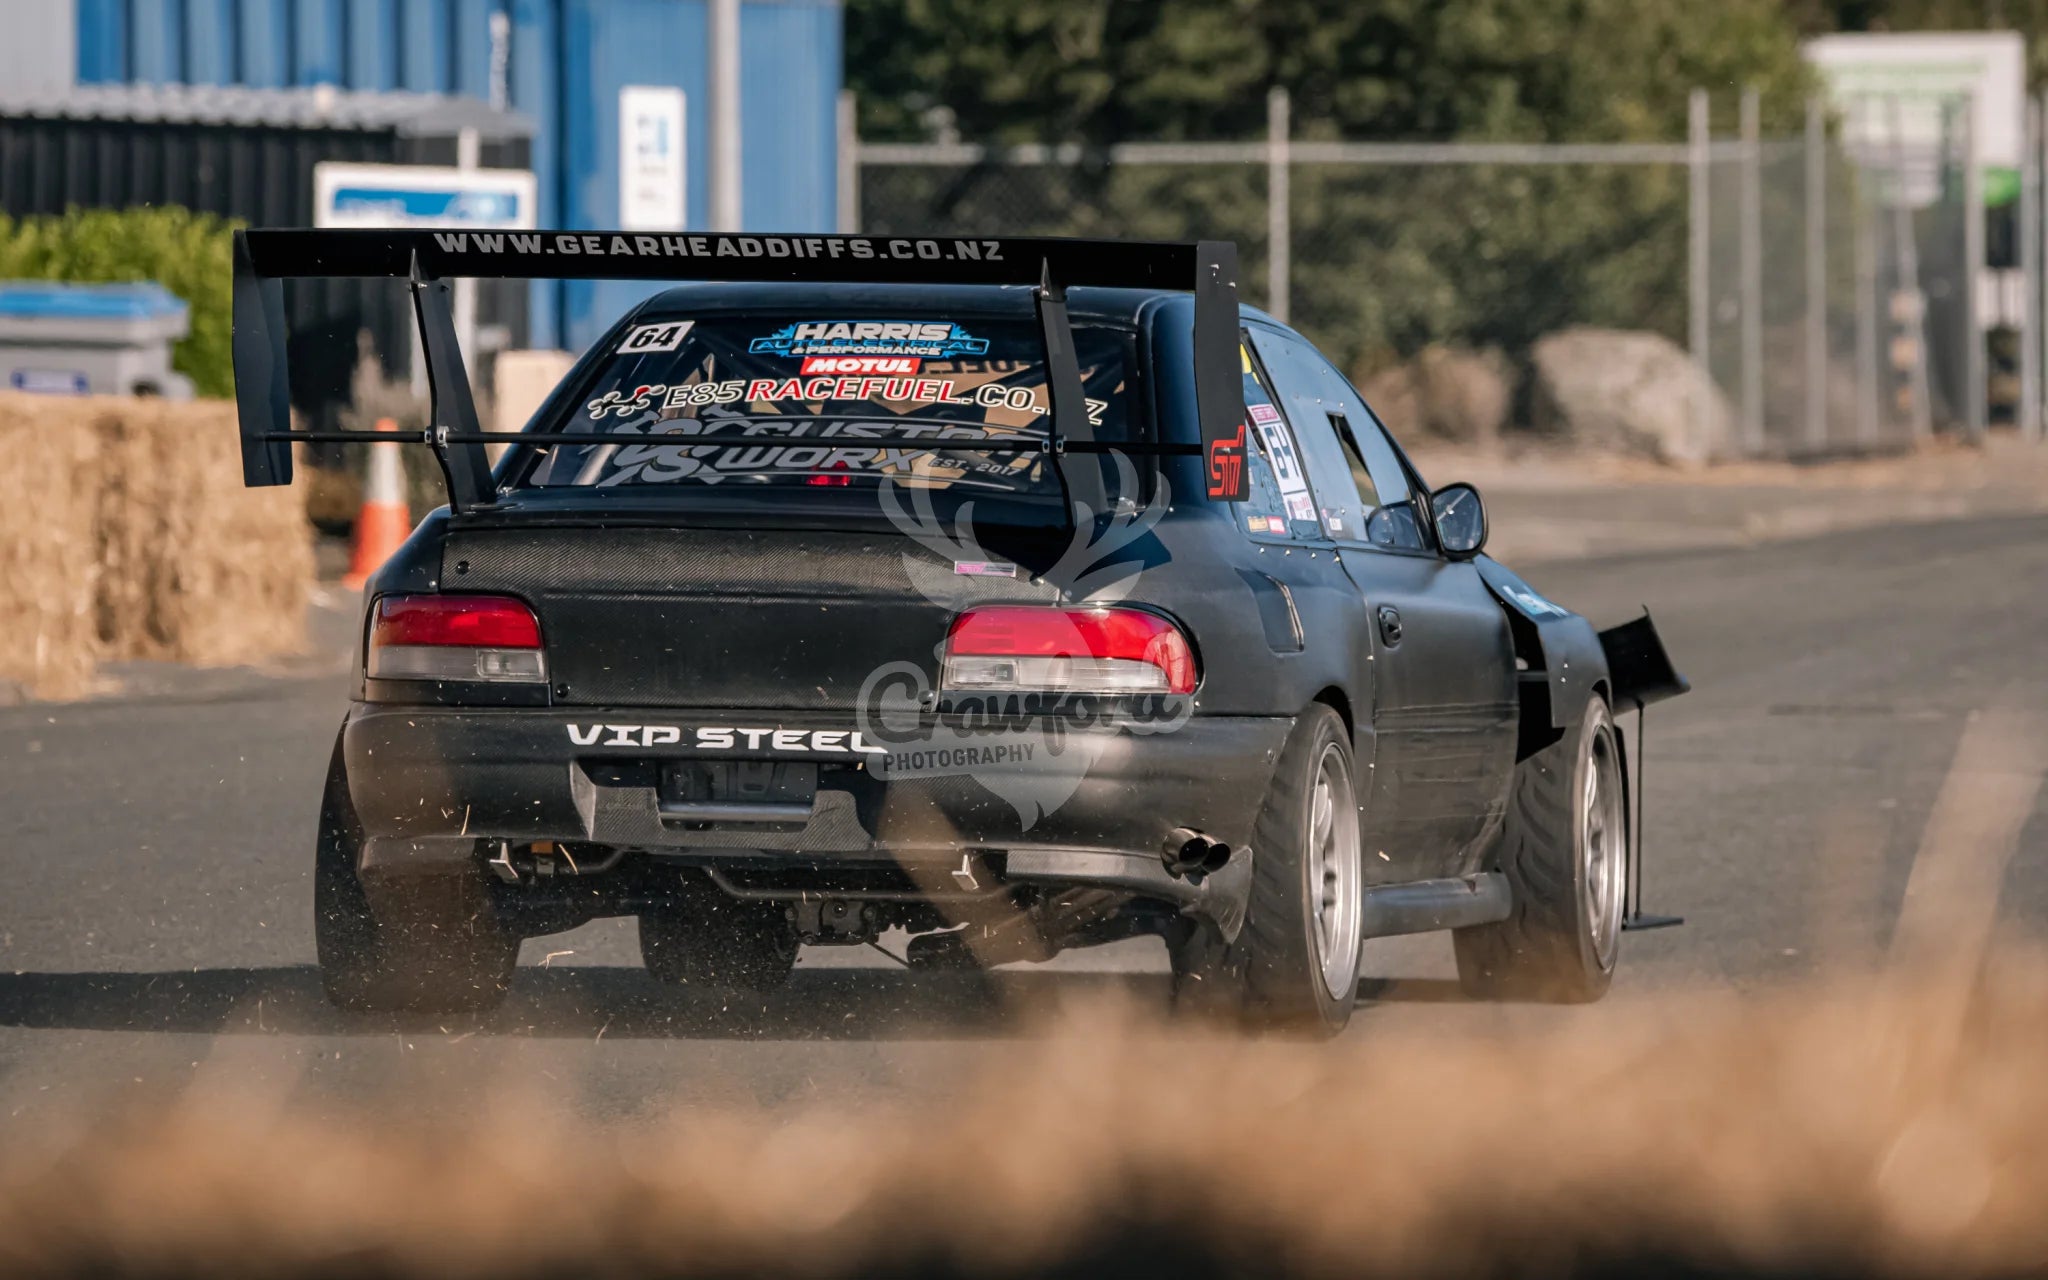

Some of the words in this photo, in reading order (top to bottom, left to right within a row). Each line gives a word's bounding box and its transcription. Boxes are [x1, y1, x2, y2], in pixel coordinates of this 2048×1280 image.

[433, 232, 1004, 261] WWW.GEARHEADDIFFS.CO.NZ
[629, 326, 682, 348] 64
[794, 322, 952, 341] HARRIS
[757, 339, 825, 349] AUTO
[831, 338, 982, 351] ELECTRICAL
[806, 357, 913, 373] MOTUL
[662, 376, 1108, 426] E85RACEFUEL.CO.Z
[928, 457, 971, 471] EST.
[978, 462, 1022, 477] 2017
[566, 723, 680, 747] VIP
[696, 726, 888, 754] STEEL
